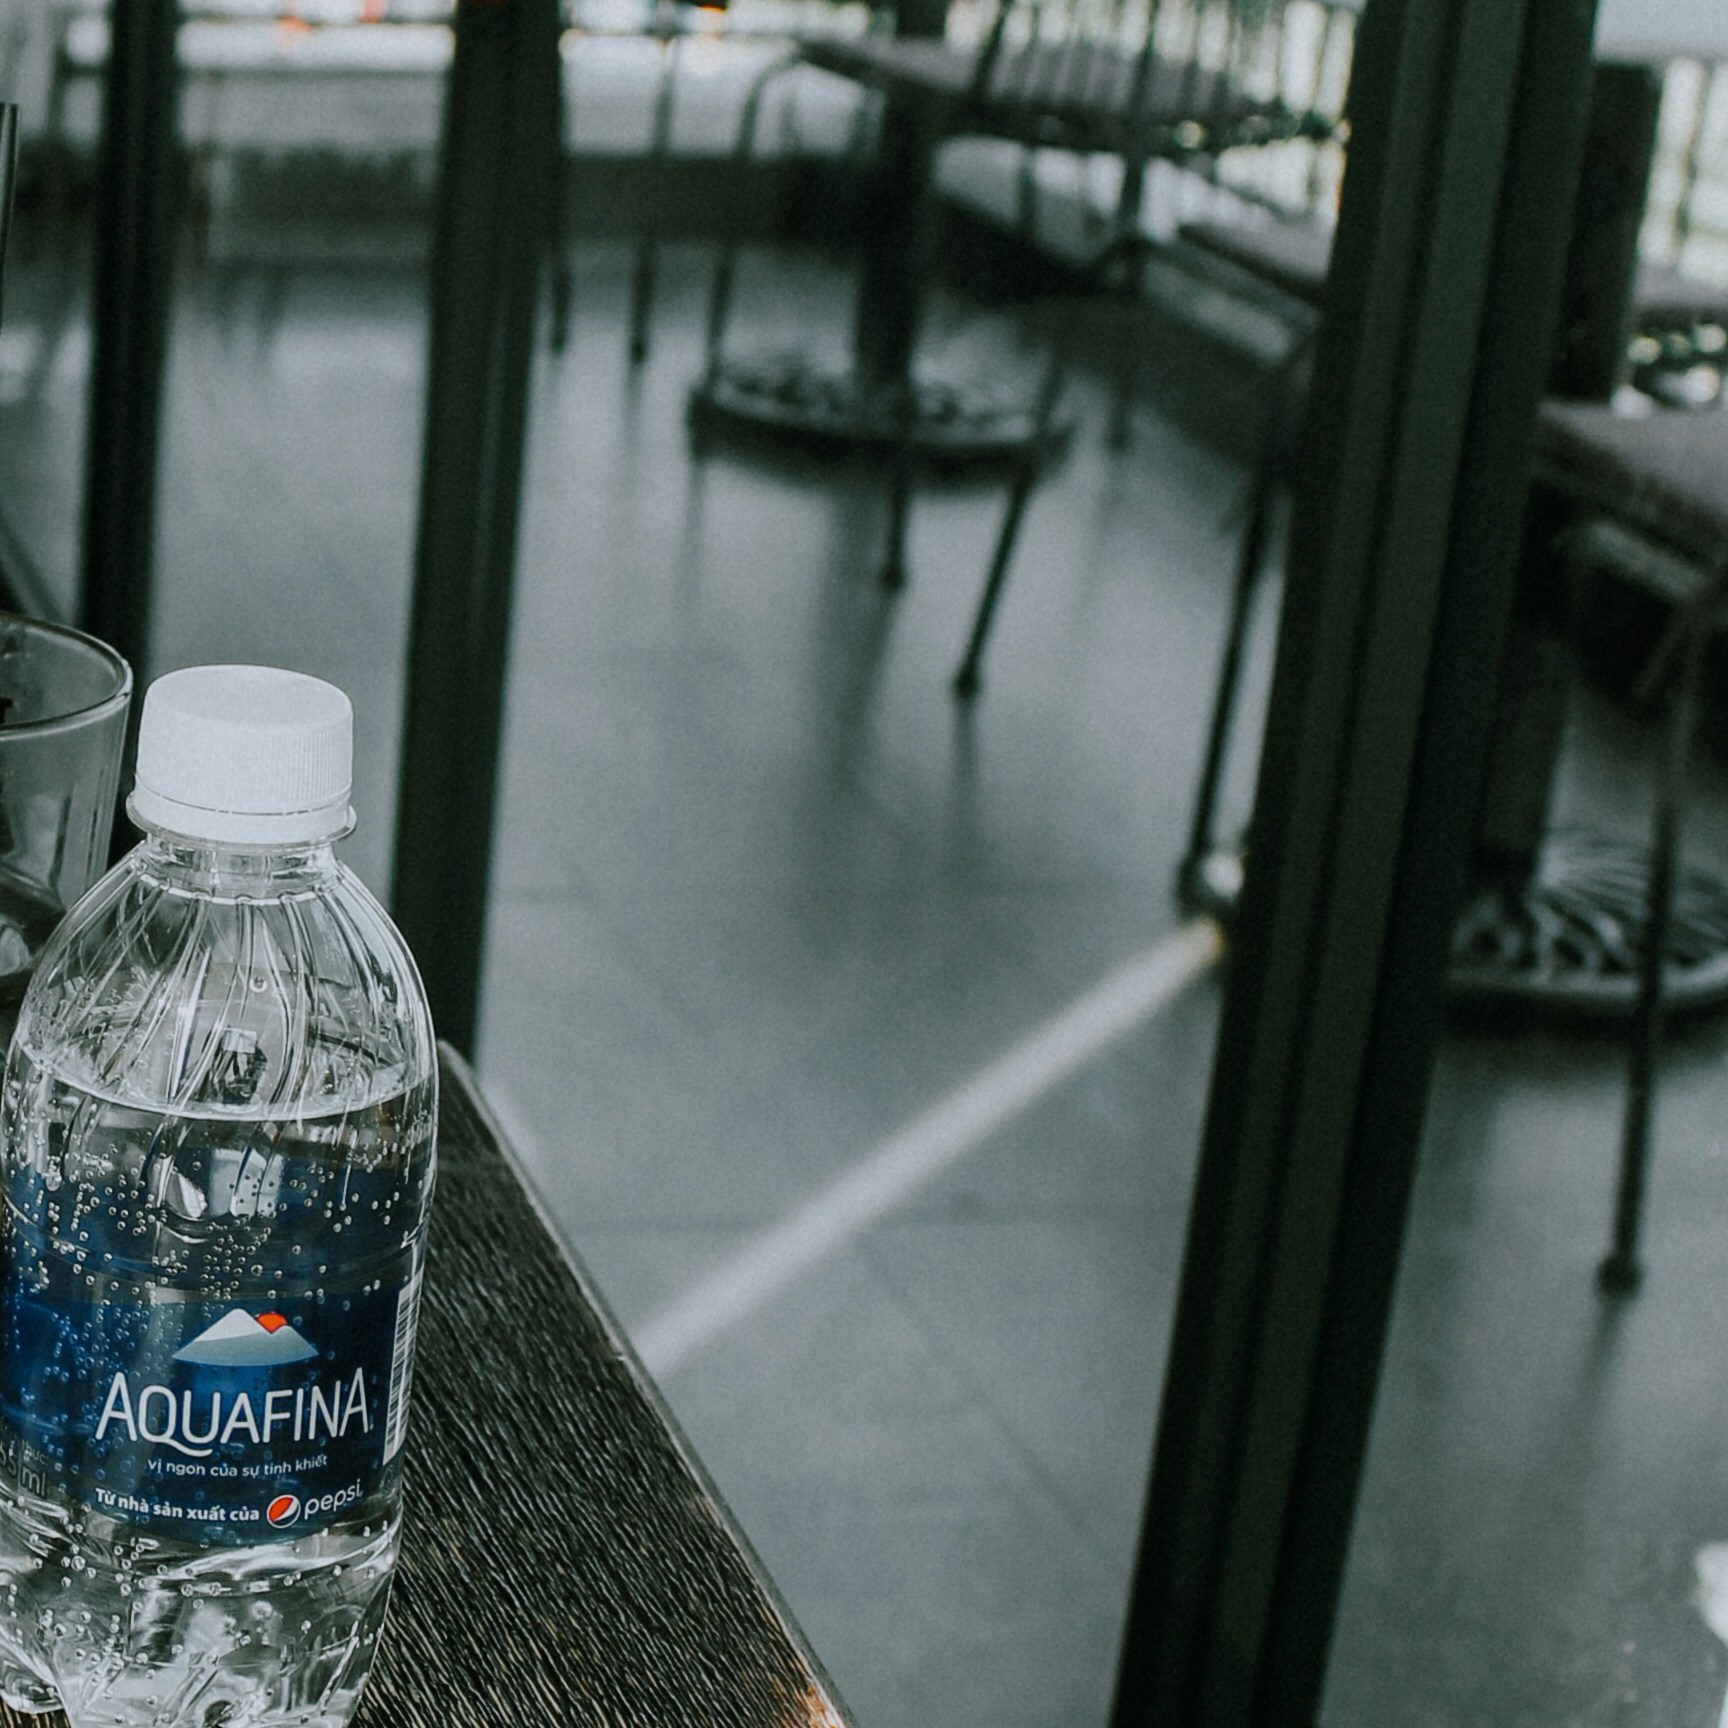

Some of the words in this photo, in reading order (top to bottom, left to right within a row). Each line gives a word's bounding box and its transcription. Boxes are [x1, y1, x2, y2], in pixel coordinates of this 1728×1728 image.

[96, 1366, 368, 1456] AQUAFINA
[148, 1459, 161, 1474] vị
[167, 1463, 205, 1475] ngon
[210, 1463, 237, 1476] của
[96, 1488, 116, 1505] Từ
[117, 1496, 149, 1515] nhà
[154, 1501, 182, 1517] sản
[185, 1504, 227, 1522] xuất
[230, 1506, 259, 1521] của
[304, 1479, 362, 1520] pepsi
